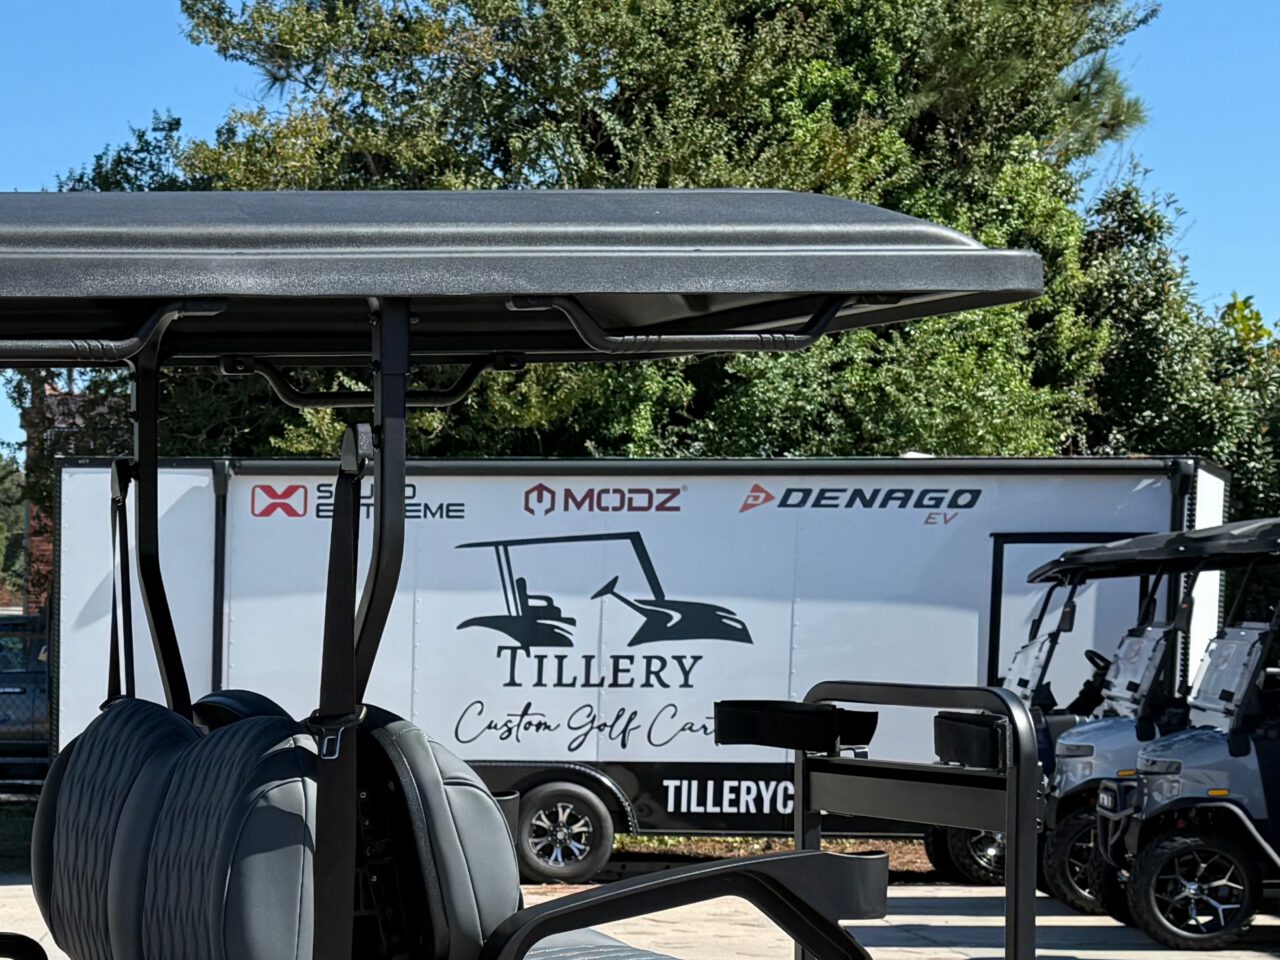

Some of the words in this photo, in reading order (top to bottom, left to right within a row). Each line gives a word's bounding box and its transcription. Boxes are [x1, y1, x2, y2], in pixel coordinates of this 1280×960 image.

[317, 483, 416, 499] SUD
[777, 488, 983, 509] DENAGO
[316, 503, 465, 519] ETEME
[923, 512, 959, 525] EV
[496, 645, 704, 689] TILLERY
[454, 700, 561, 744] Custom
[567, 704, 641, 752] Golf
[647, 703, 715, 747] Car
